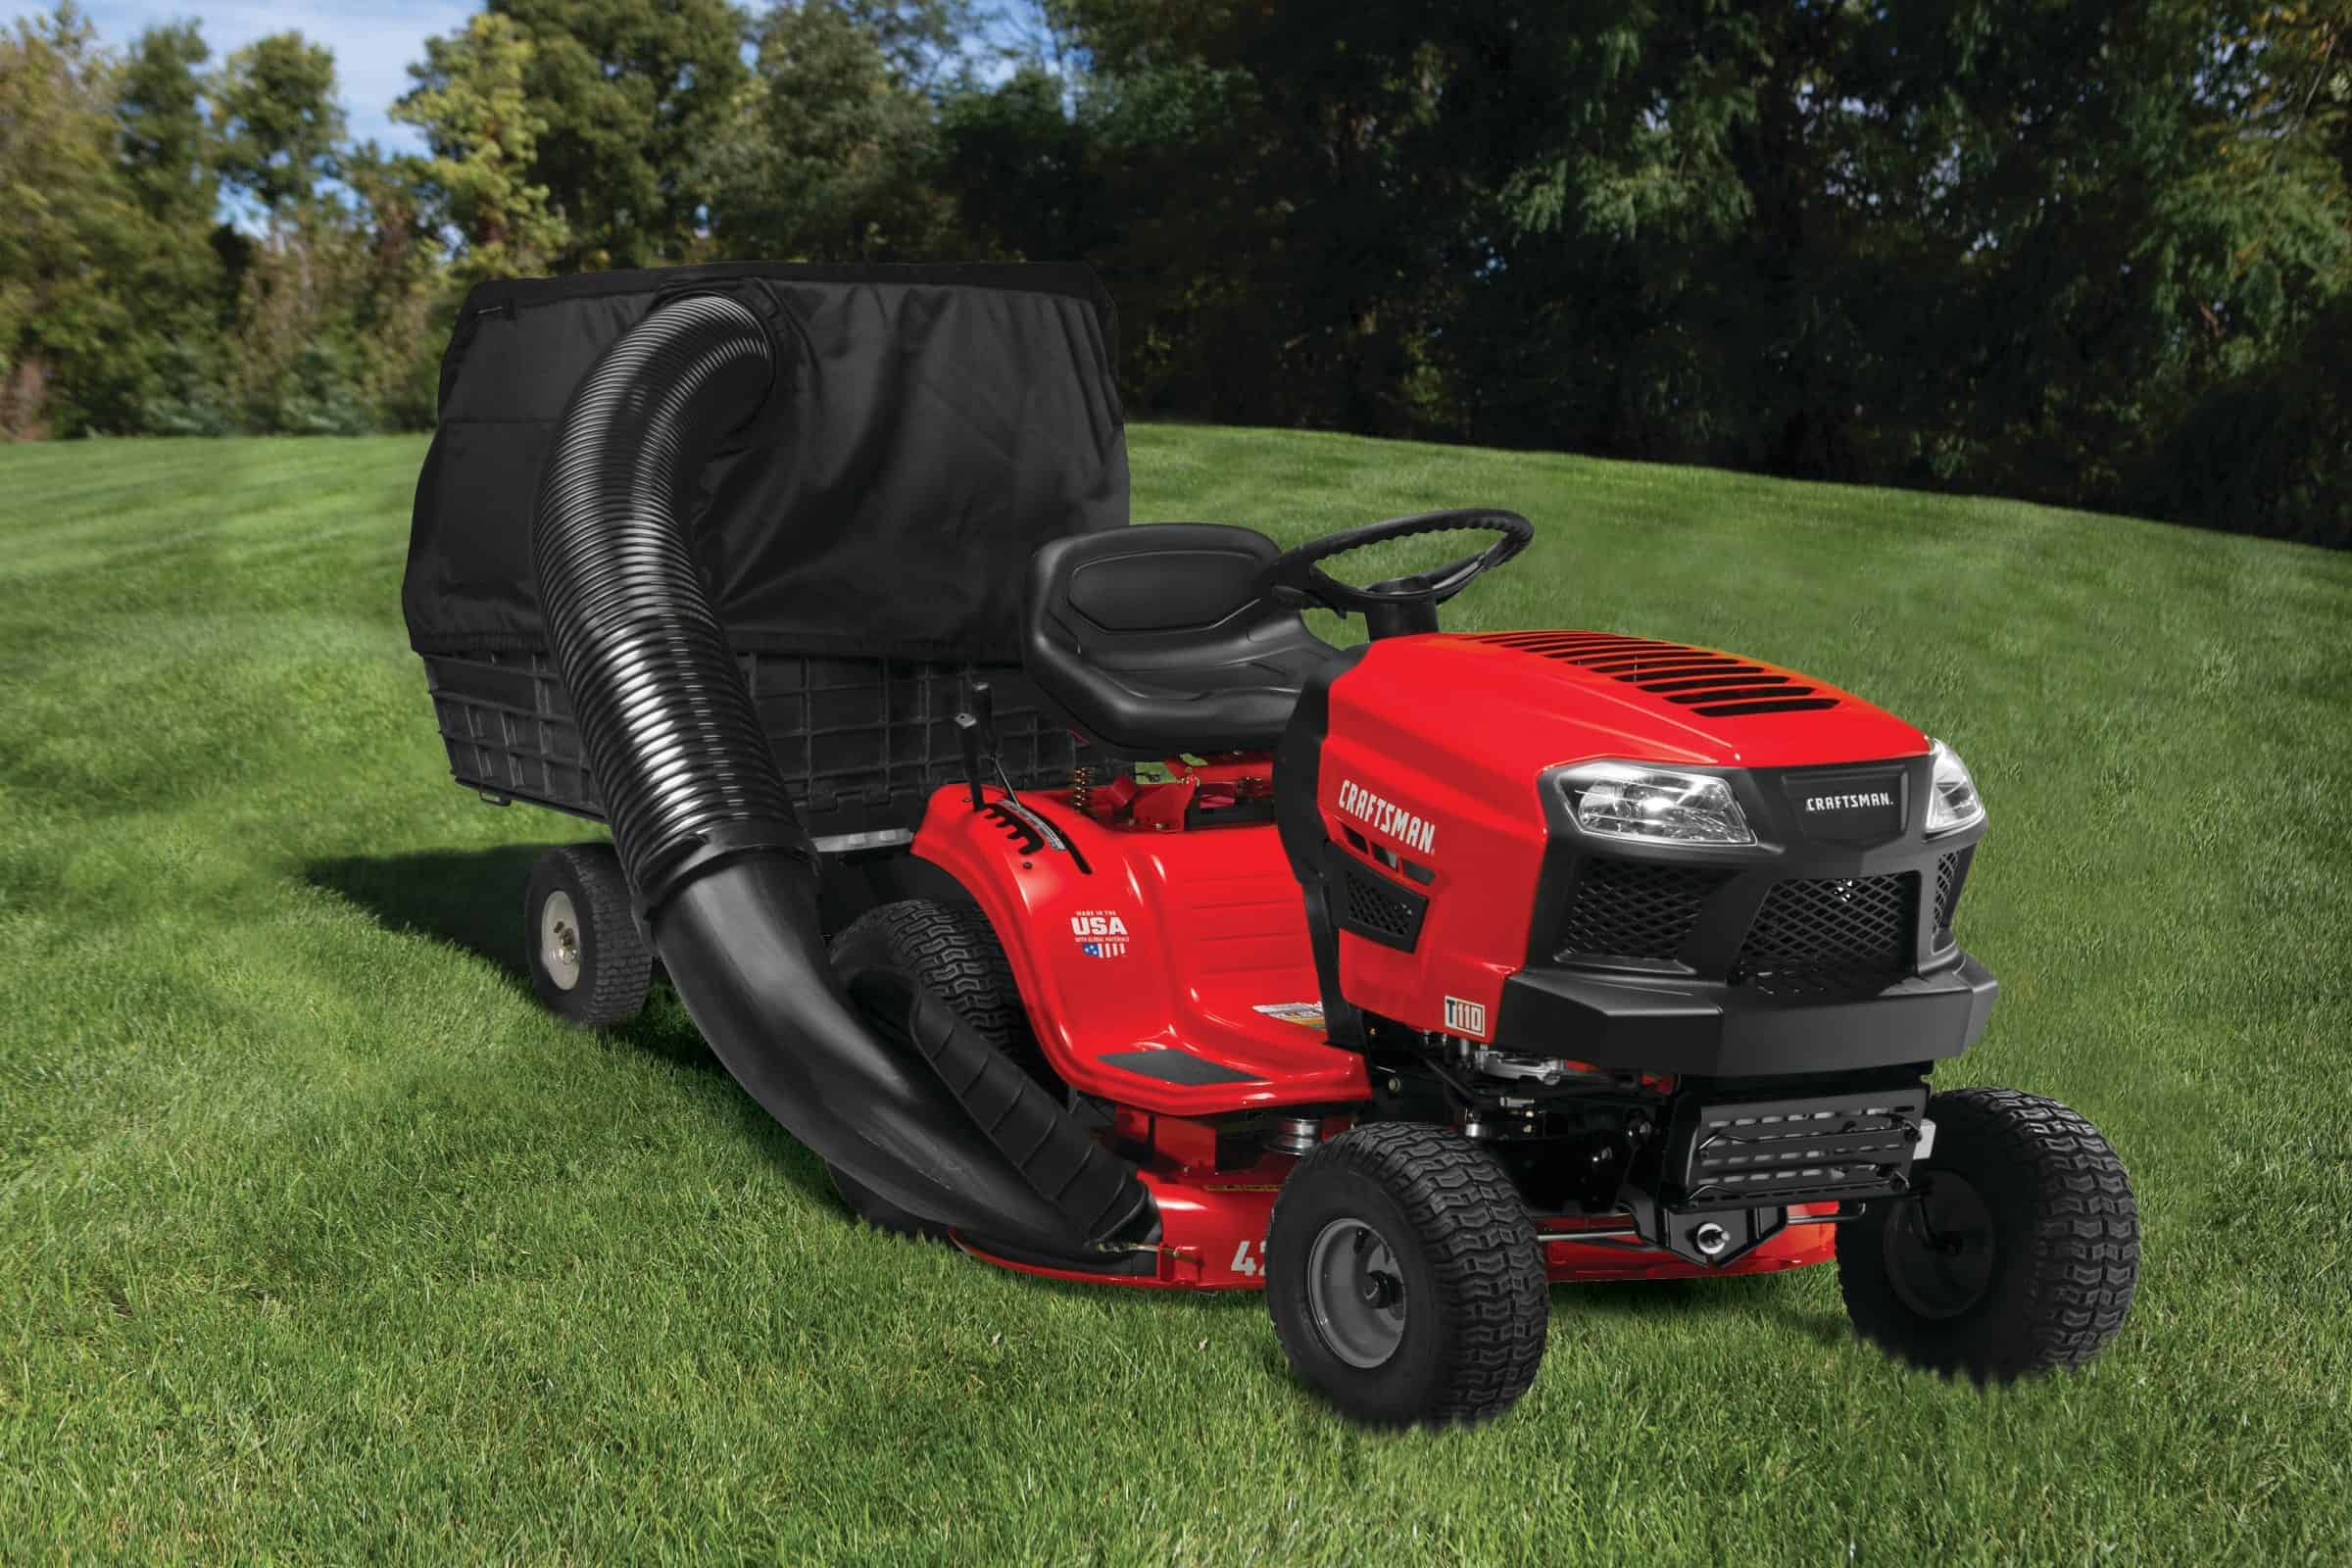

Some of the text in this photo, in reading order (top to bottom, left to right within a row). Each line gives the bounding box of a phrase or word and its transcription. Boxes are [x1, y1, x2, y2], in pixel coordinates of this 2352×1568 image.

[1339, 779, 1435, 855] CRAFTSMAN
[1071, 916, 1128, 935] USA
[1446, 998, 1482, 1033] T110
